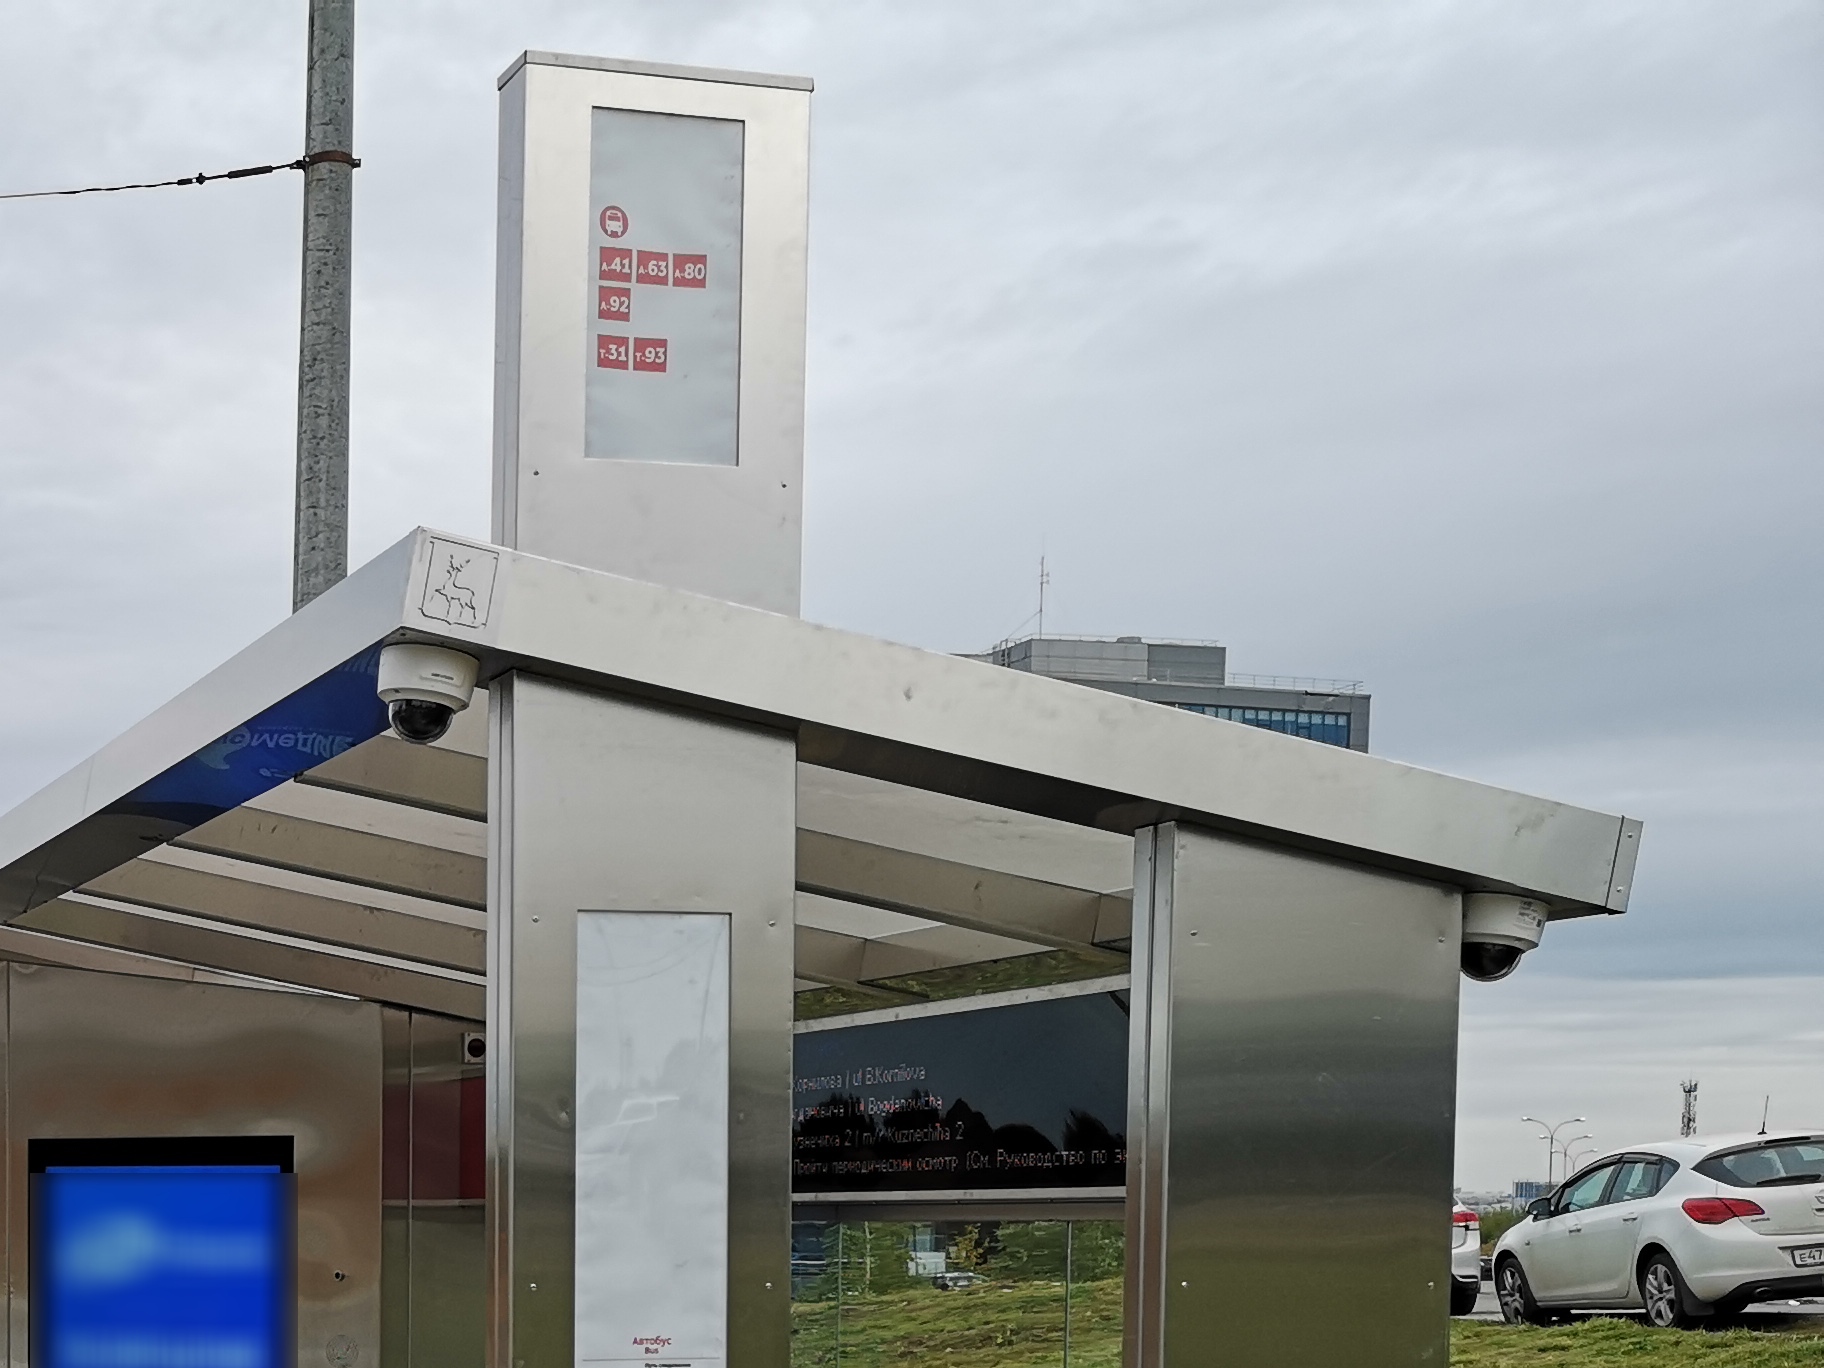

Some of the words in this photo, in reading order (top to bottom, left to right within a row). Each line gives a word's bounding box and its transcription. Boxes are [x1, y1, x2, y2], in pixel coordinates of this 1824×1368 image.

[601, 256, 631, 274] А-41
[638, 260, 667, 277] А-63
[674, 263, 706, 280] А-80
[600, 296, 630, 313] А-92
[599, 344, 628, 361] Т-31
[635, 347, 666, 364] Т-93
[955, 1121, 965, 1140] 2
[996, 1149, 1085, 1170] Руководство
[1091, 1150, 1108, 1164] по
[632, 1336, 672, 1347] Автобус
